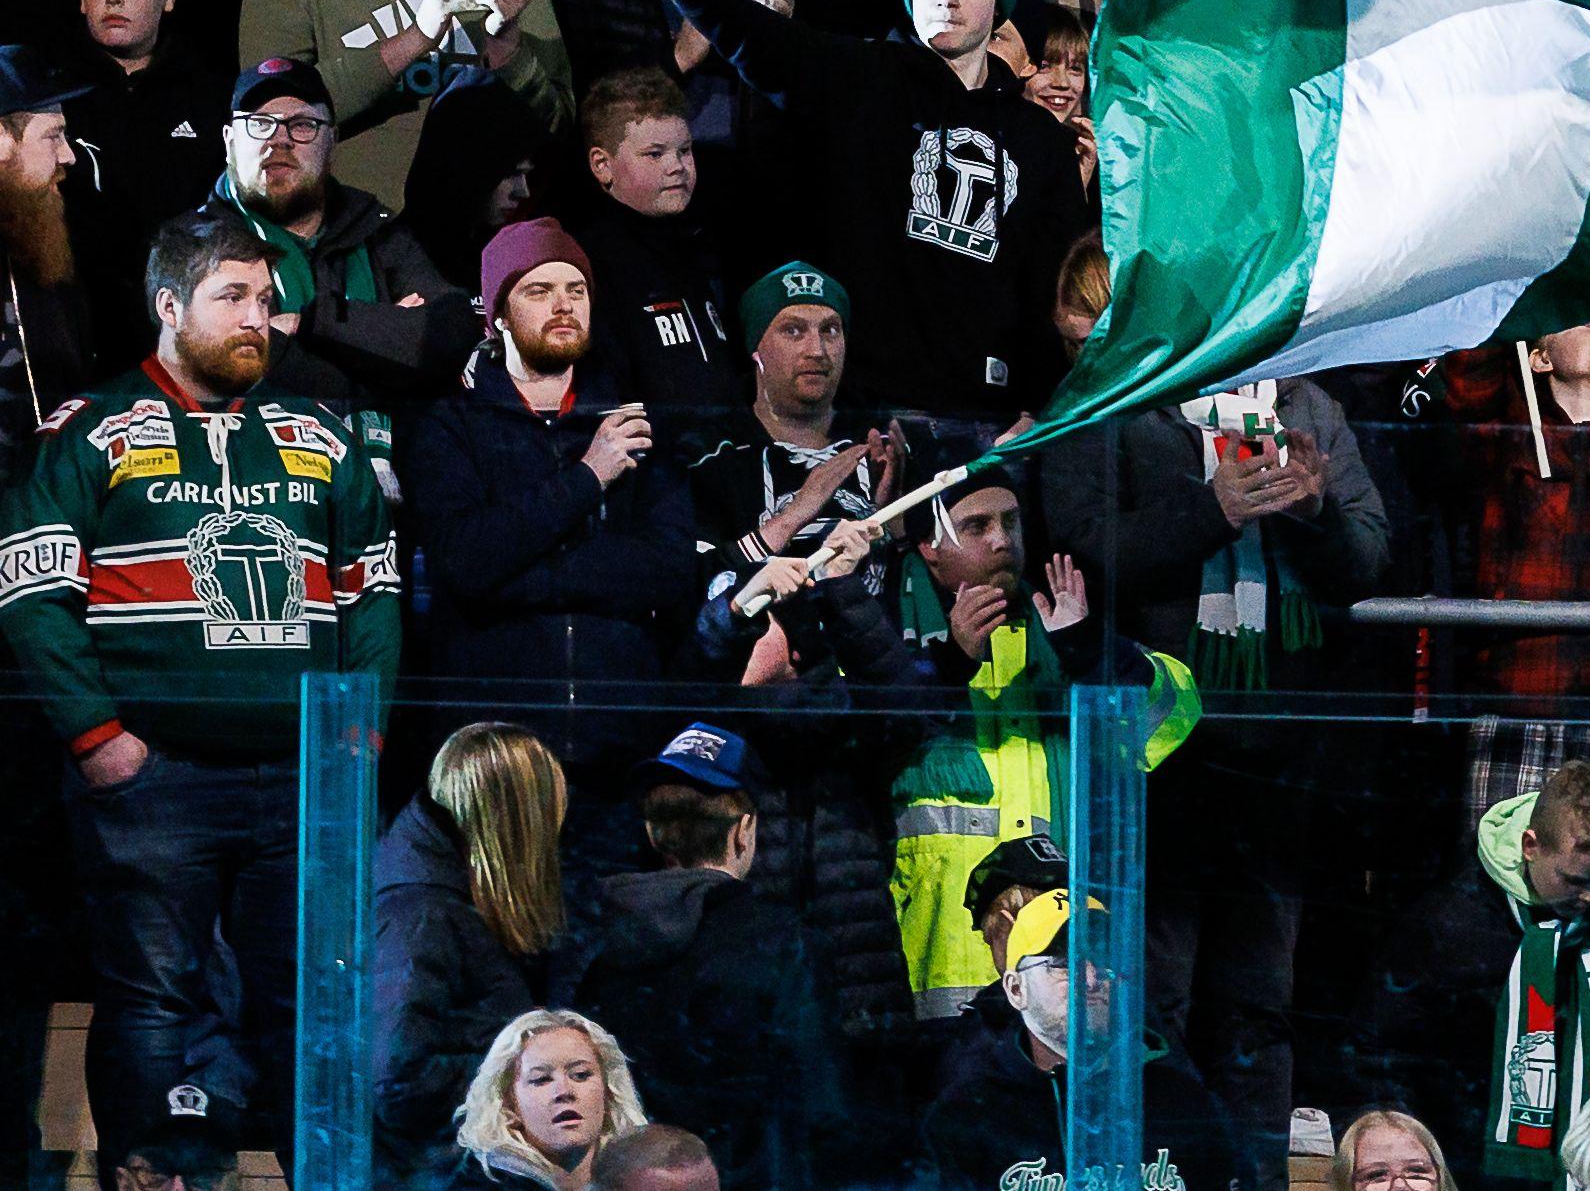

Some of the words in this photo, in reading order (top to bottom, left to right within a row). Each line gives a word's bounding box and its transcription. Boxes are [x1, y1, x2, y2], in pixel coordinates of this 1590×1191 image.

[654, 312, 691, 346] RN
[288, 481, 318, 506] BIL
[226, 625, 298, 644] AIF
